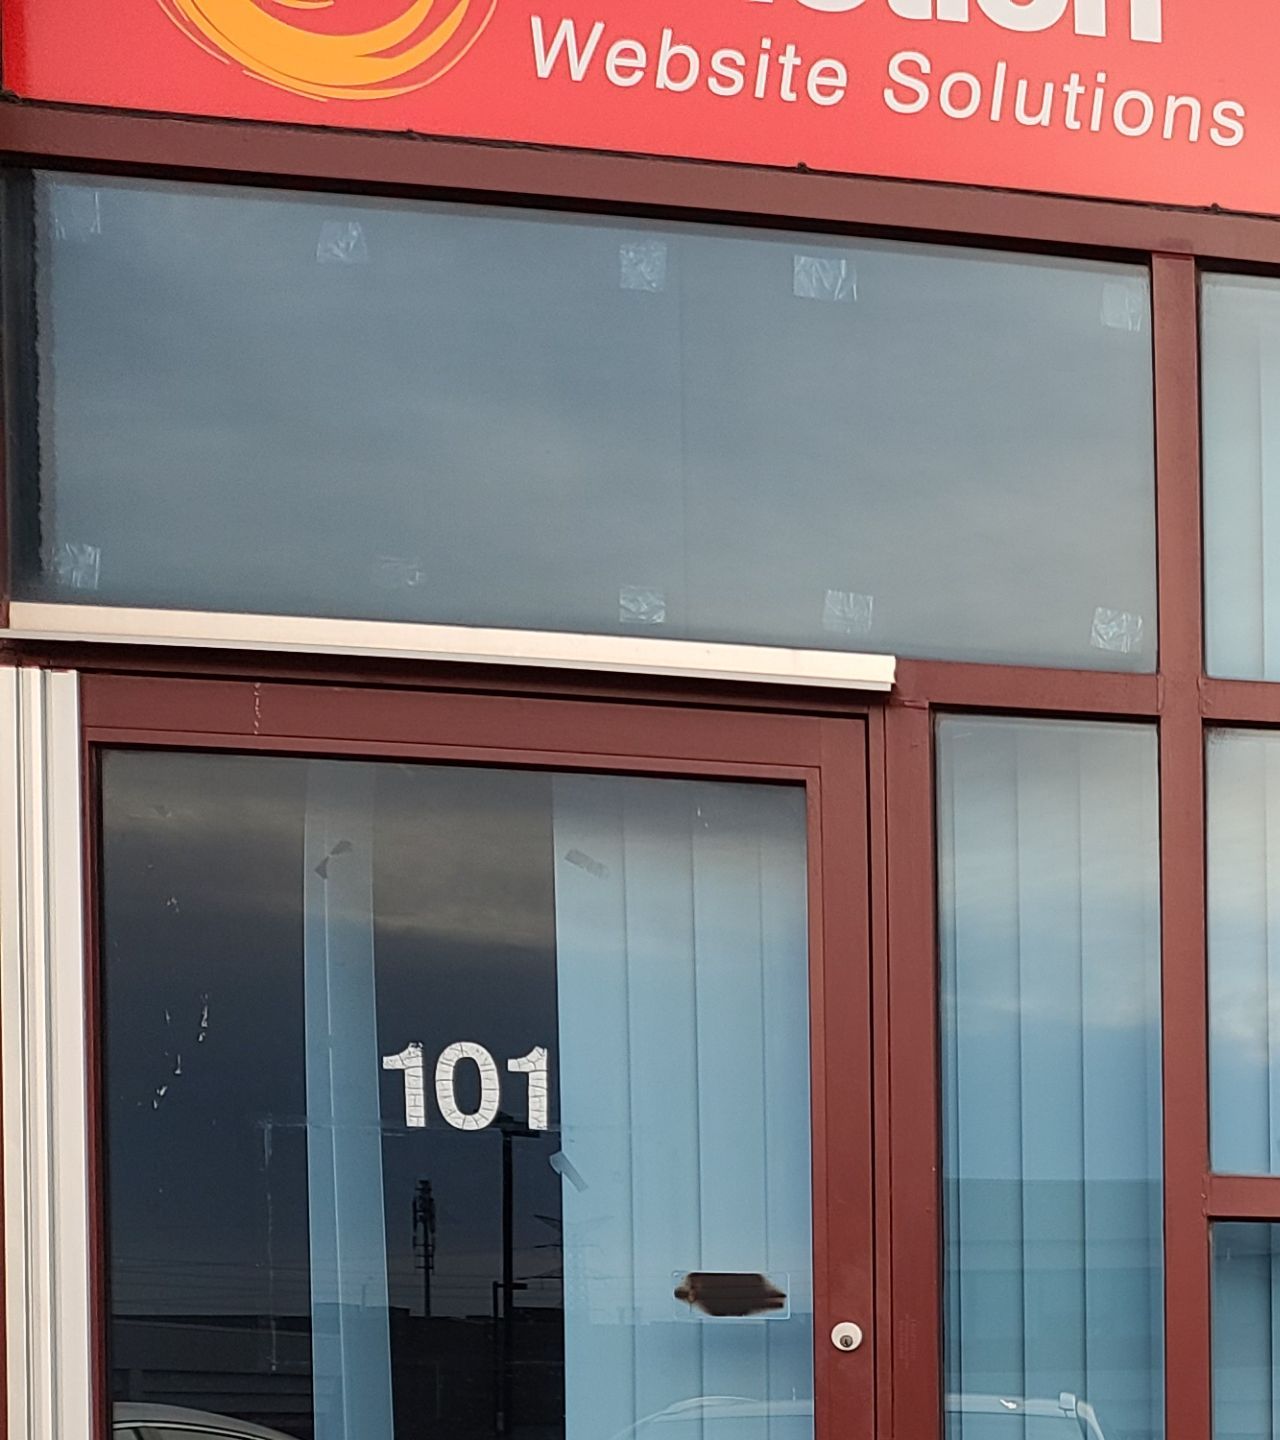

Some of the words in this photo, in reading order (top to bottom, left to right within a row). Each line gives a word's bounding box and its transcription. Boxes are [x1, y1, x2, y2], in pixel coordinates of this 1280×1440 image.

[529, 15, 848, 106] Website
[883, 51, 1247, 148] Solutions
[382, 1041, 549, 1131] 101
